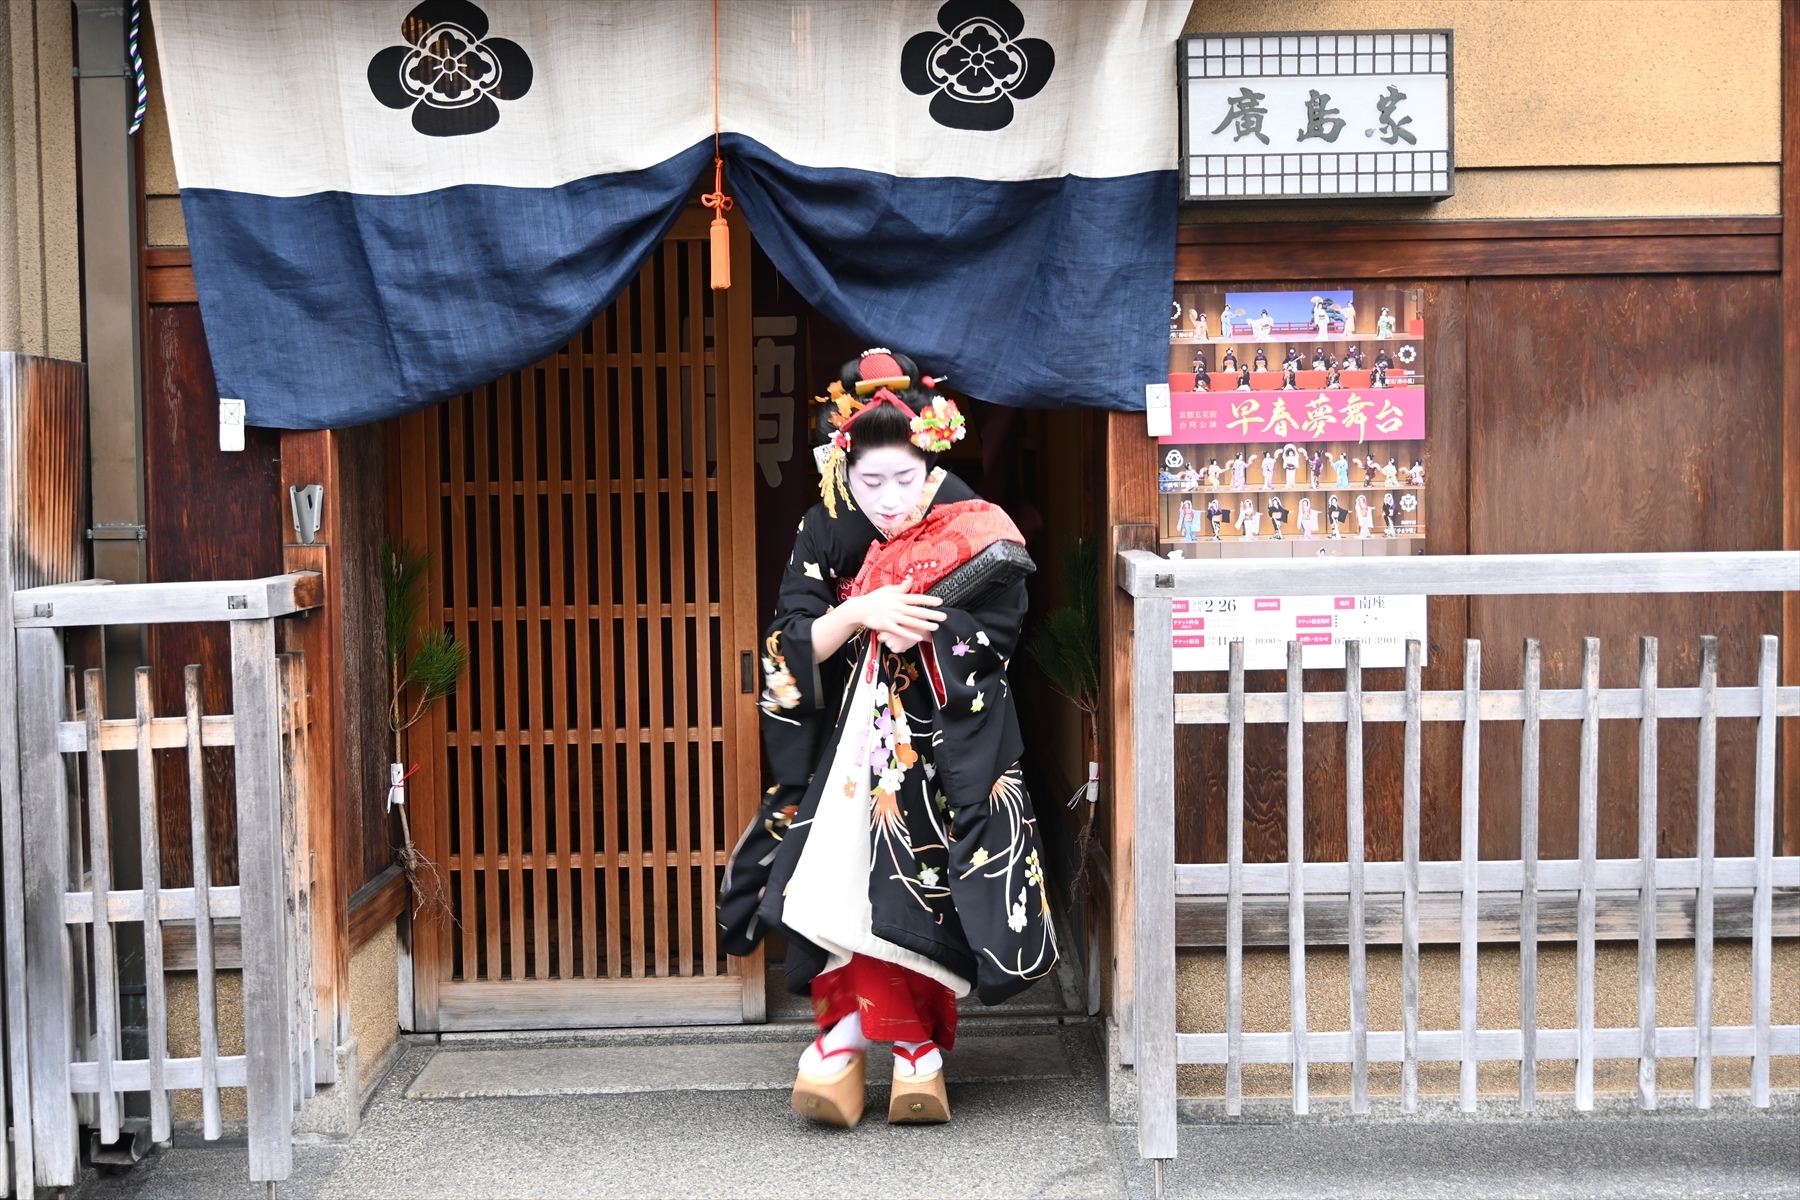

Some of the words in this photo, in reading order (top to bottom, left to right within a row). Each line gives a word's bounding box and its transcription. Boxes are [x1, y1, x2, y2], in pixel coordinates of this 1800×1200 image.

[1211, 85, 1417, 145] 廣島家
[1178, 410, 1218, 419] 京都五花街
[1225, 392, 1404, 445] 早春夢舞台
[1178, 420, 1218, 429] 合同公演
[1205, 599, 1214, 613] 2
[1218, 599, 1237, 613] 26
